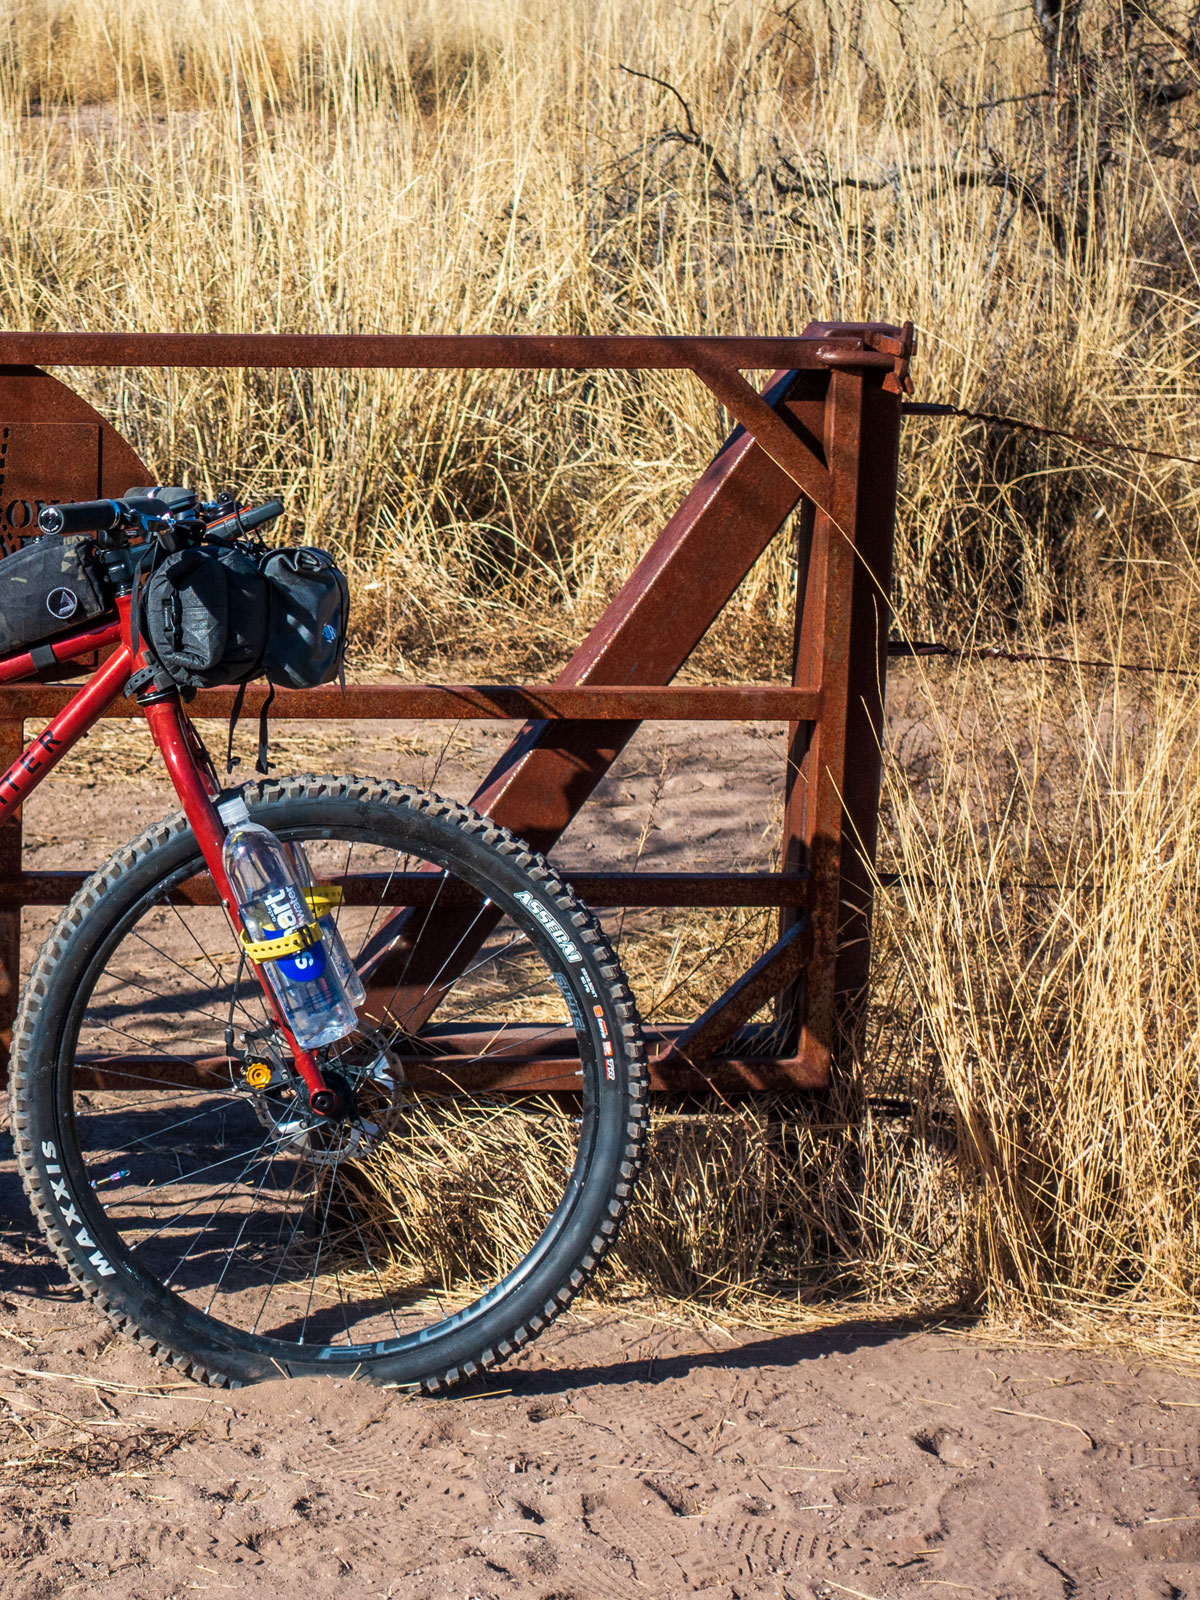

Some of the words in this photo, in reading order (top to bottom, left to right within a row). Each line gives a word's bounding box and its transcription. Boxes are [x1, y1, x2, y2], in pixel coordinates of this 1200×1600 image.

[513, 890, 583, 963] ASSEGAI
[41, 1140, 117, 1277] MAXXIS
[319, 1279, 507, 1360] FLOW
